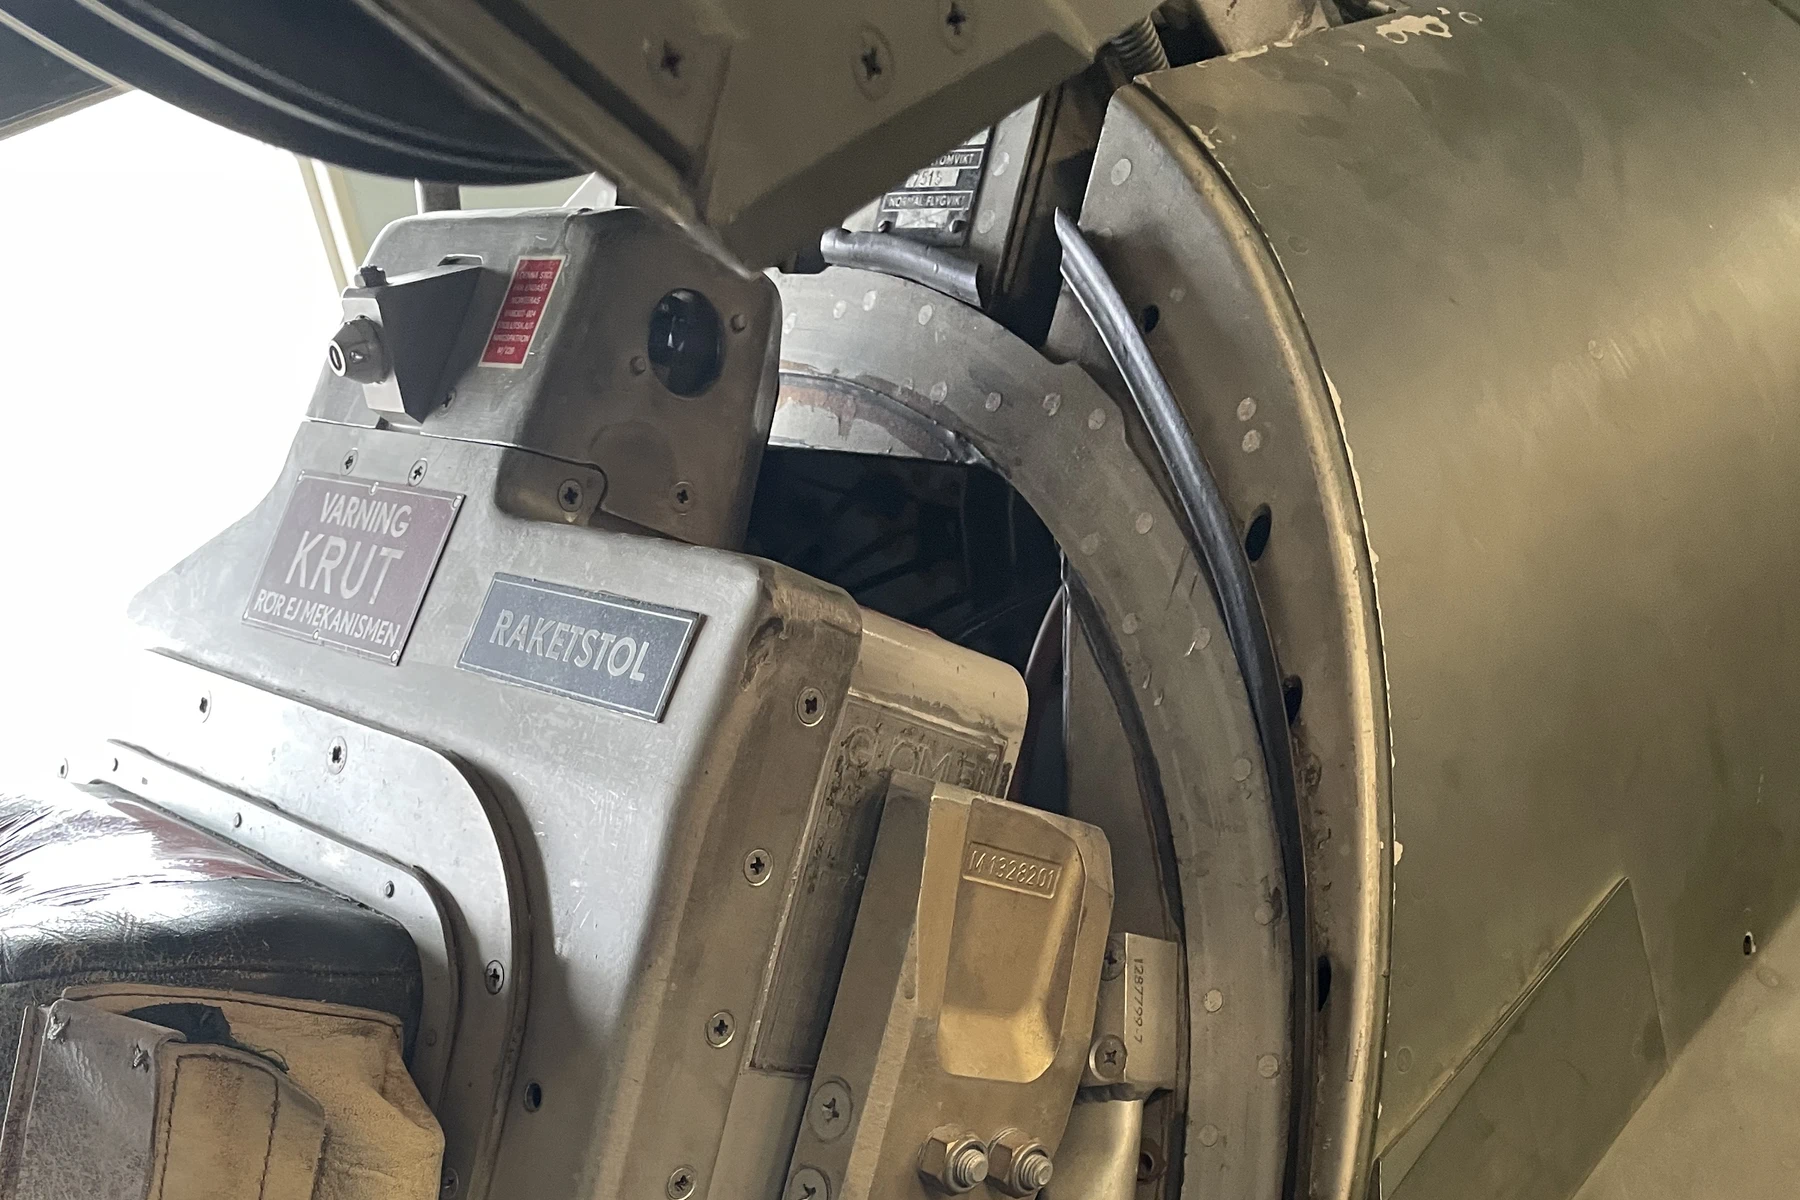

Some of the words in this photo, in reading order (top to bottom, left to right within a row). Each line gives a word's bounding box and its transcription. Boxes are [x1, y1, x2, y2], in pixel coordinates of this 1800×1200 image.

[321, 491, 412, 538] VARNING
[284, 530, 403, 605] KRUT
[283, 597, 302, 621] EJ
[300, 600, 401, 647] MEKANISMEN
[490, 608, 651, 682] RAKETSTOL
